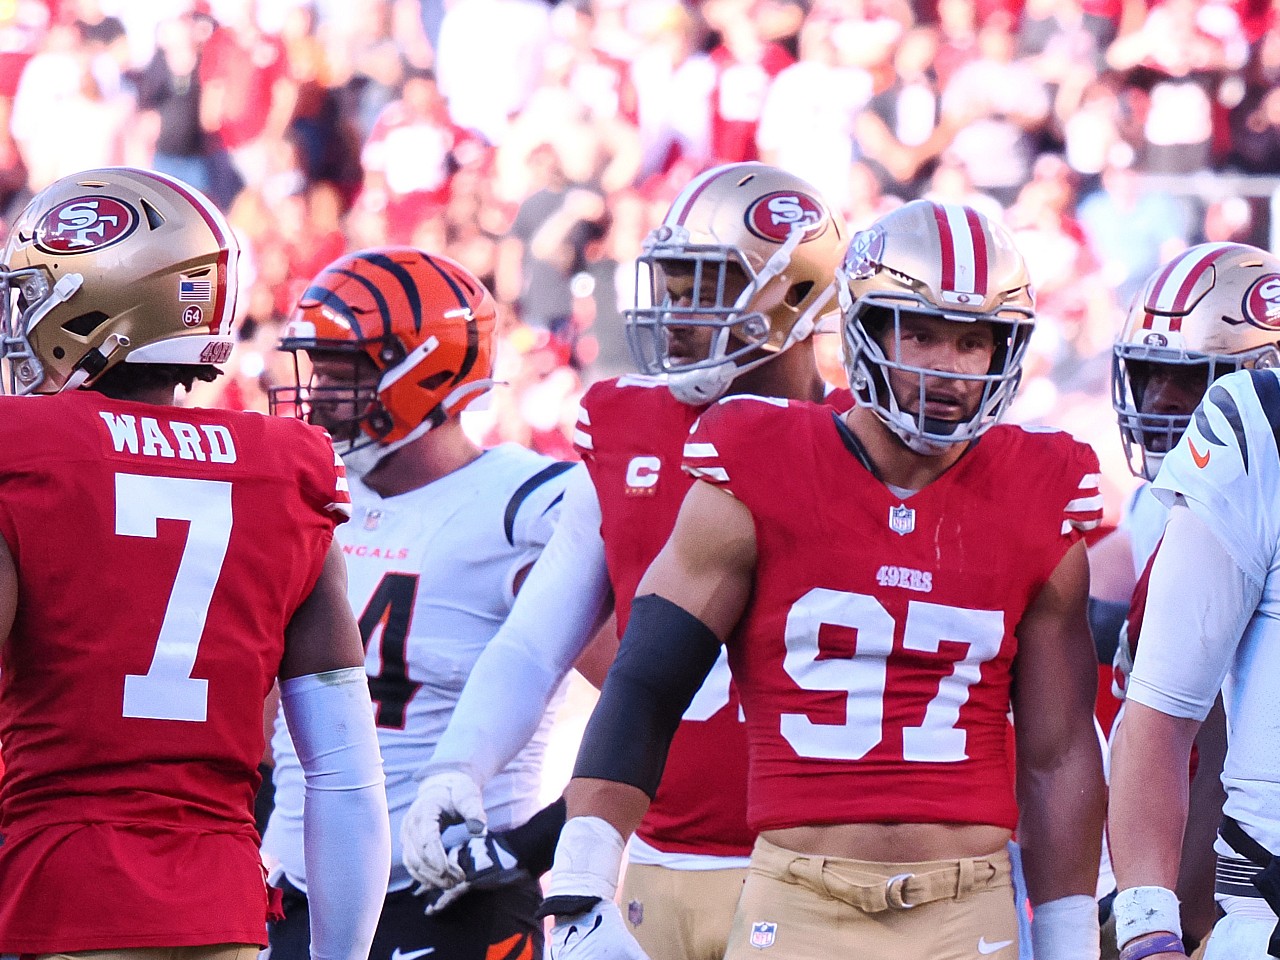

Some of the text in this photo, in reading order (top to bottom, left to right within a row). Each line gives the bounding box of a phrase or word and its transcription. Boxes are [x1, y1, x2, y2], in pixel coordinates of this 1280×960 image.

[58, 201, 118, 247] SF
[184, 309, 200, 324] 64
[98, 411, 237, 464] WARD
[626, 456, 662, 488] C
[342, 545, 409, 560] NGALS
[114, 472, 234, 722] 7
[876, 565, 933, 592] 49ERS
[358, 571, 423, 731] 4
[780, 587, 1005, 762] 97
